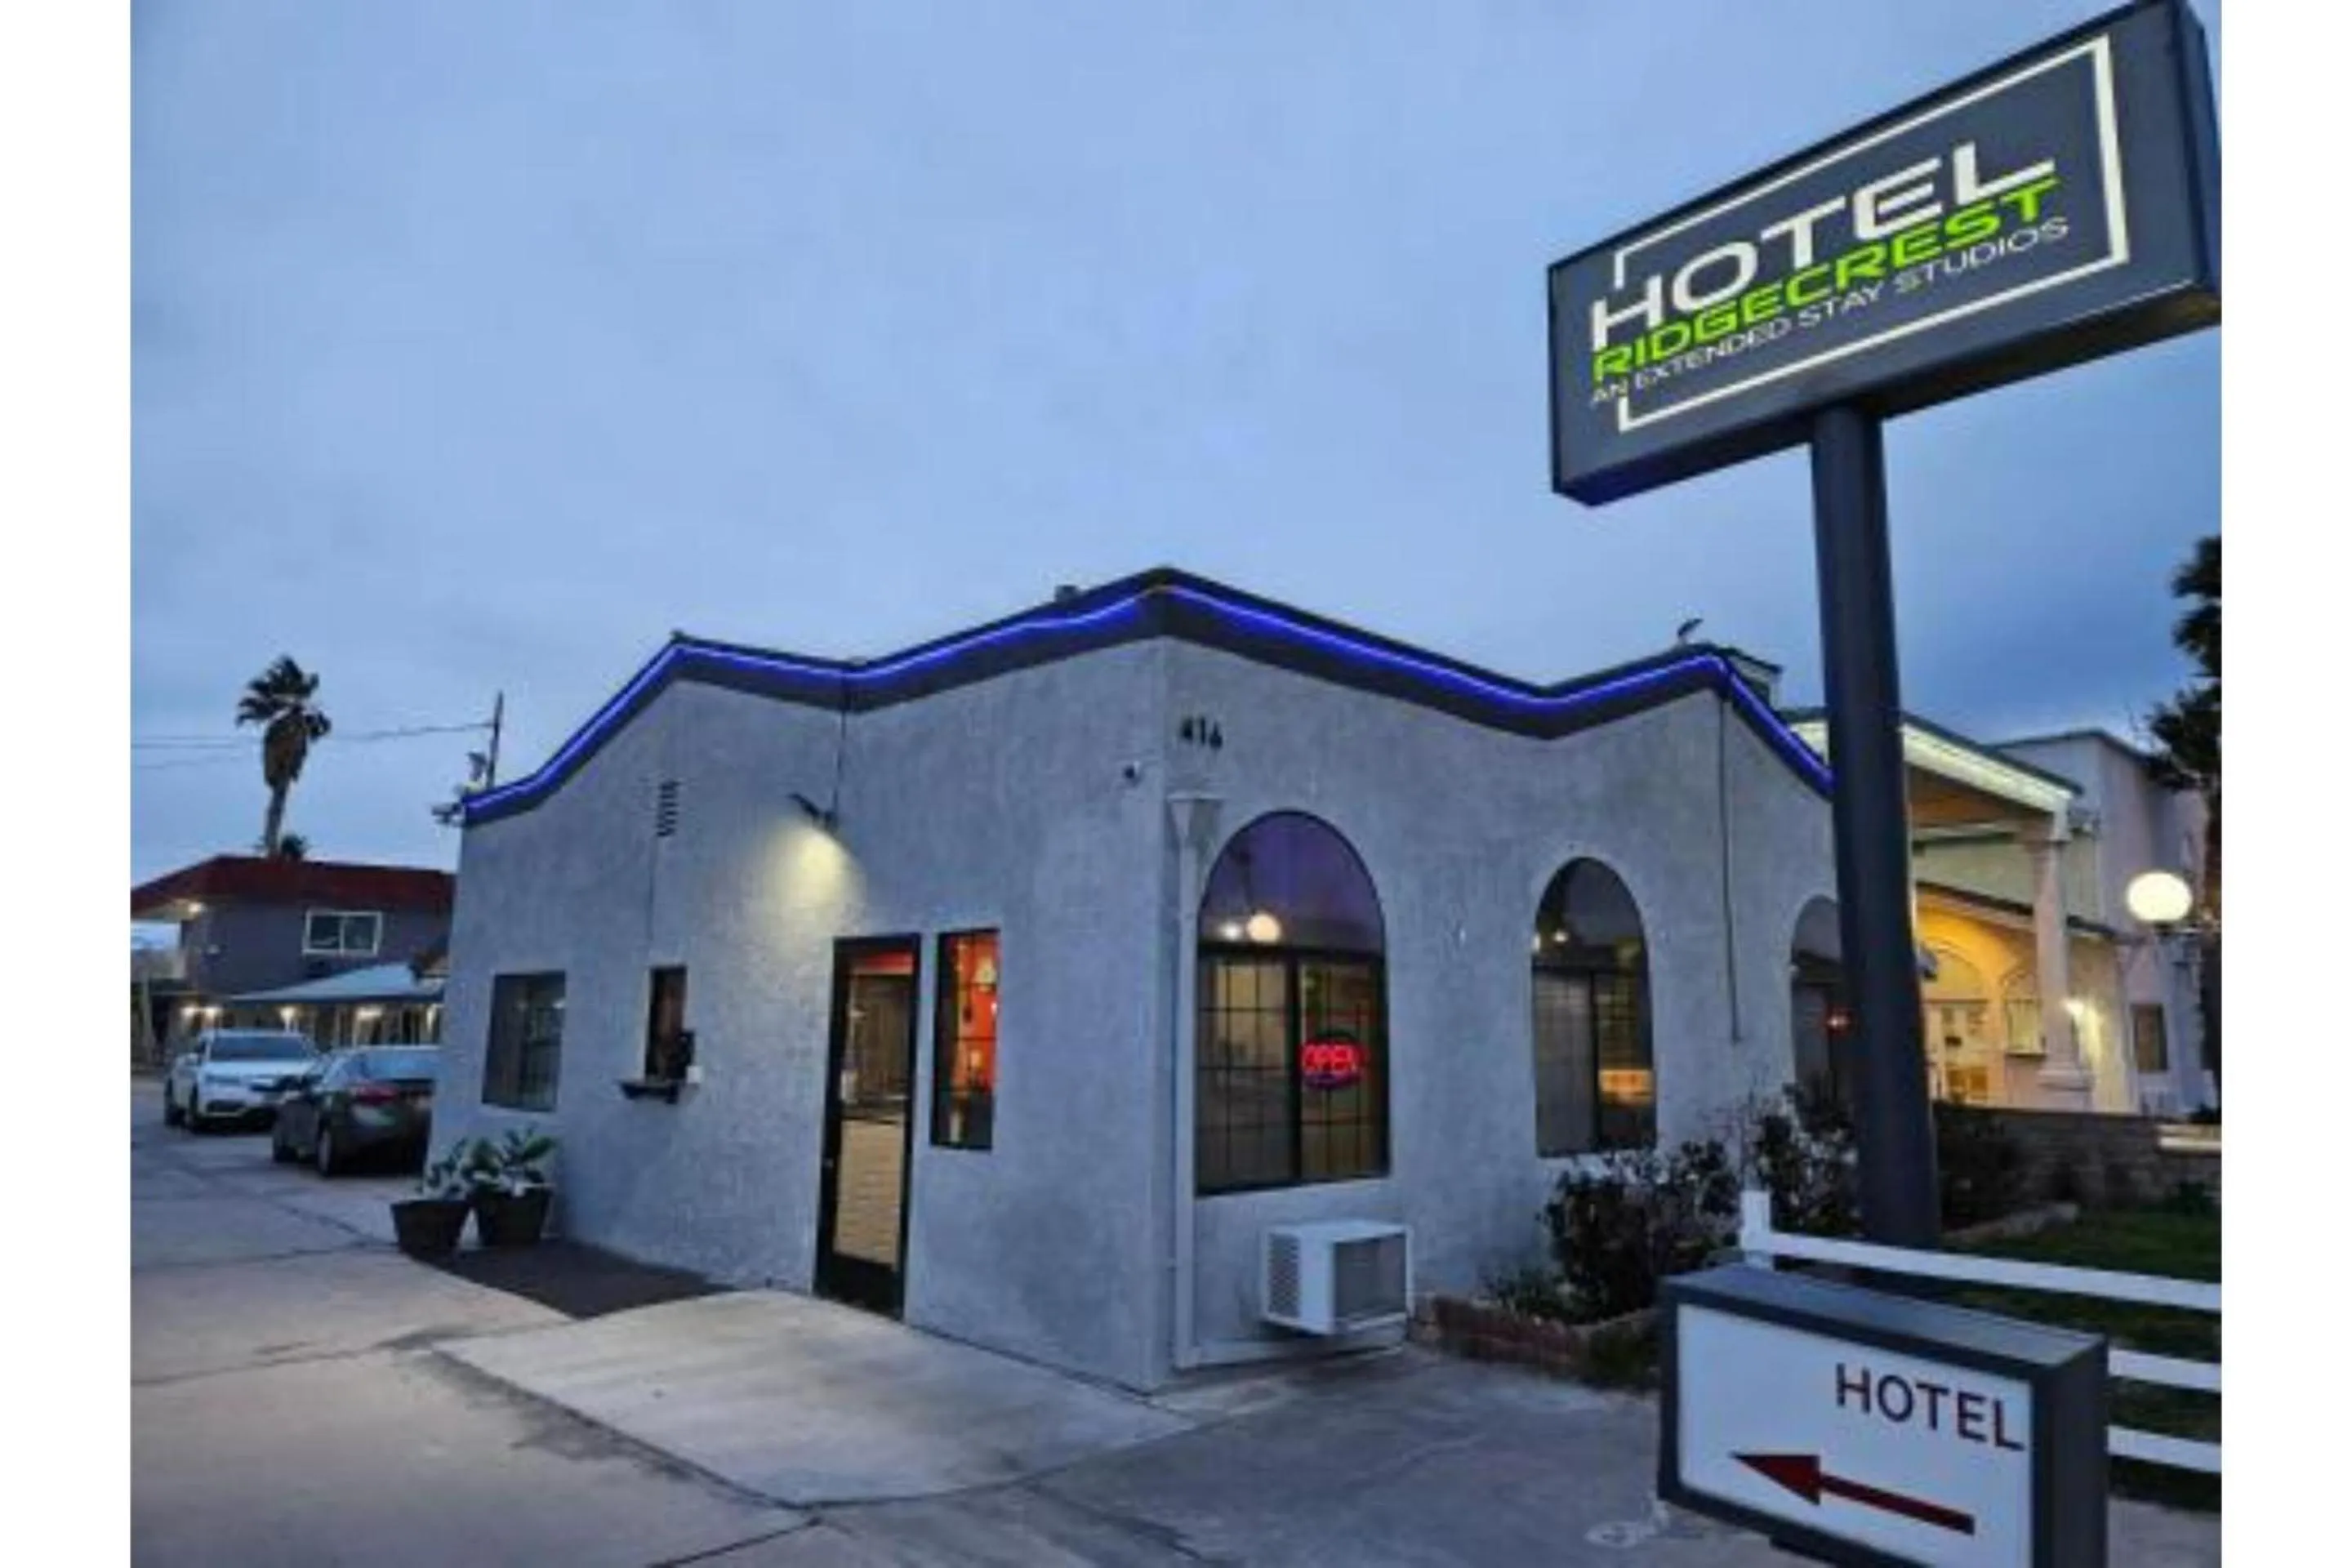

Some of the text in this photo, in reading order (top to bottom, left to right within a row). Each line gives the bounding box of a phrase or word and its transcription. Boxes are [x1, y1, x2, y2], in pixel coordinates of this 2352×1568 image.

[1591, 141, 2056, 352] HOTEL
[1592, 176, 2060, 384] RIDGECREST
[1592, 217, 2069, 407] AN EXTENDED STAY STUDIOS
[1300, 1043, 1361, 1075] OPEN
[1835, 1362, 2025, 1451] HOTEL
